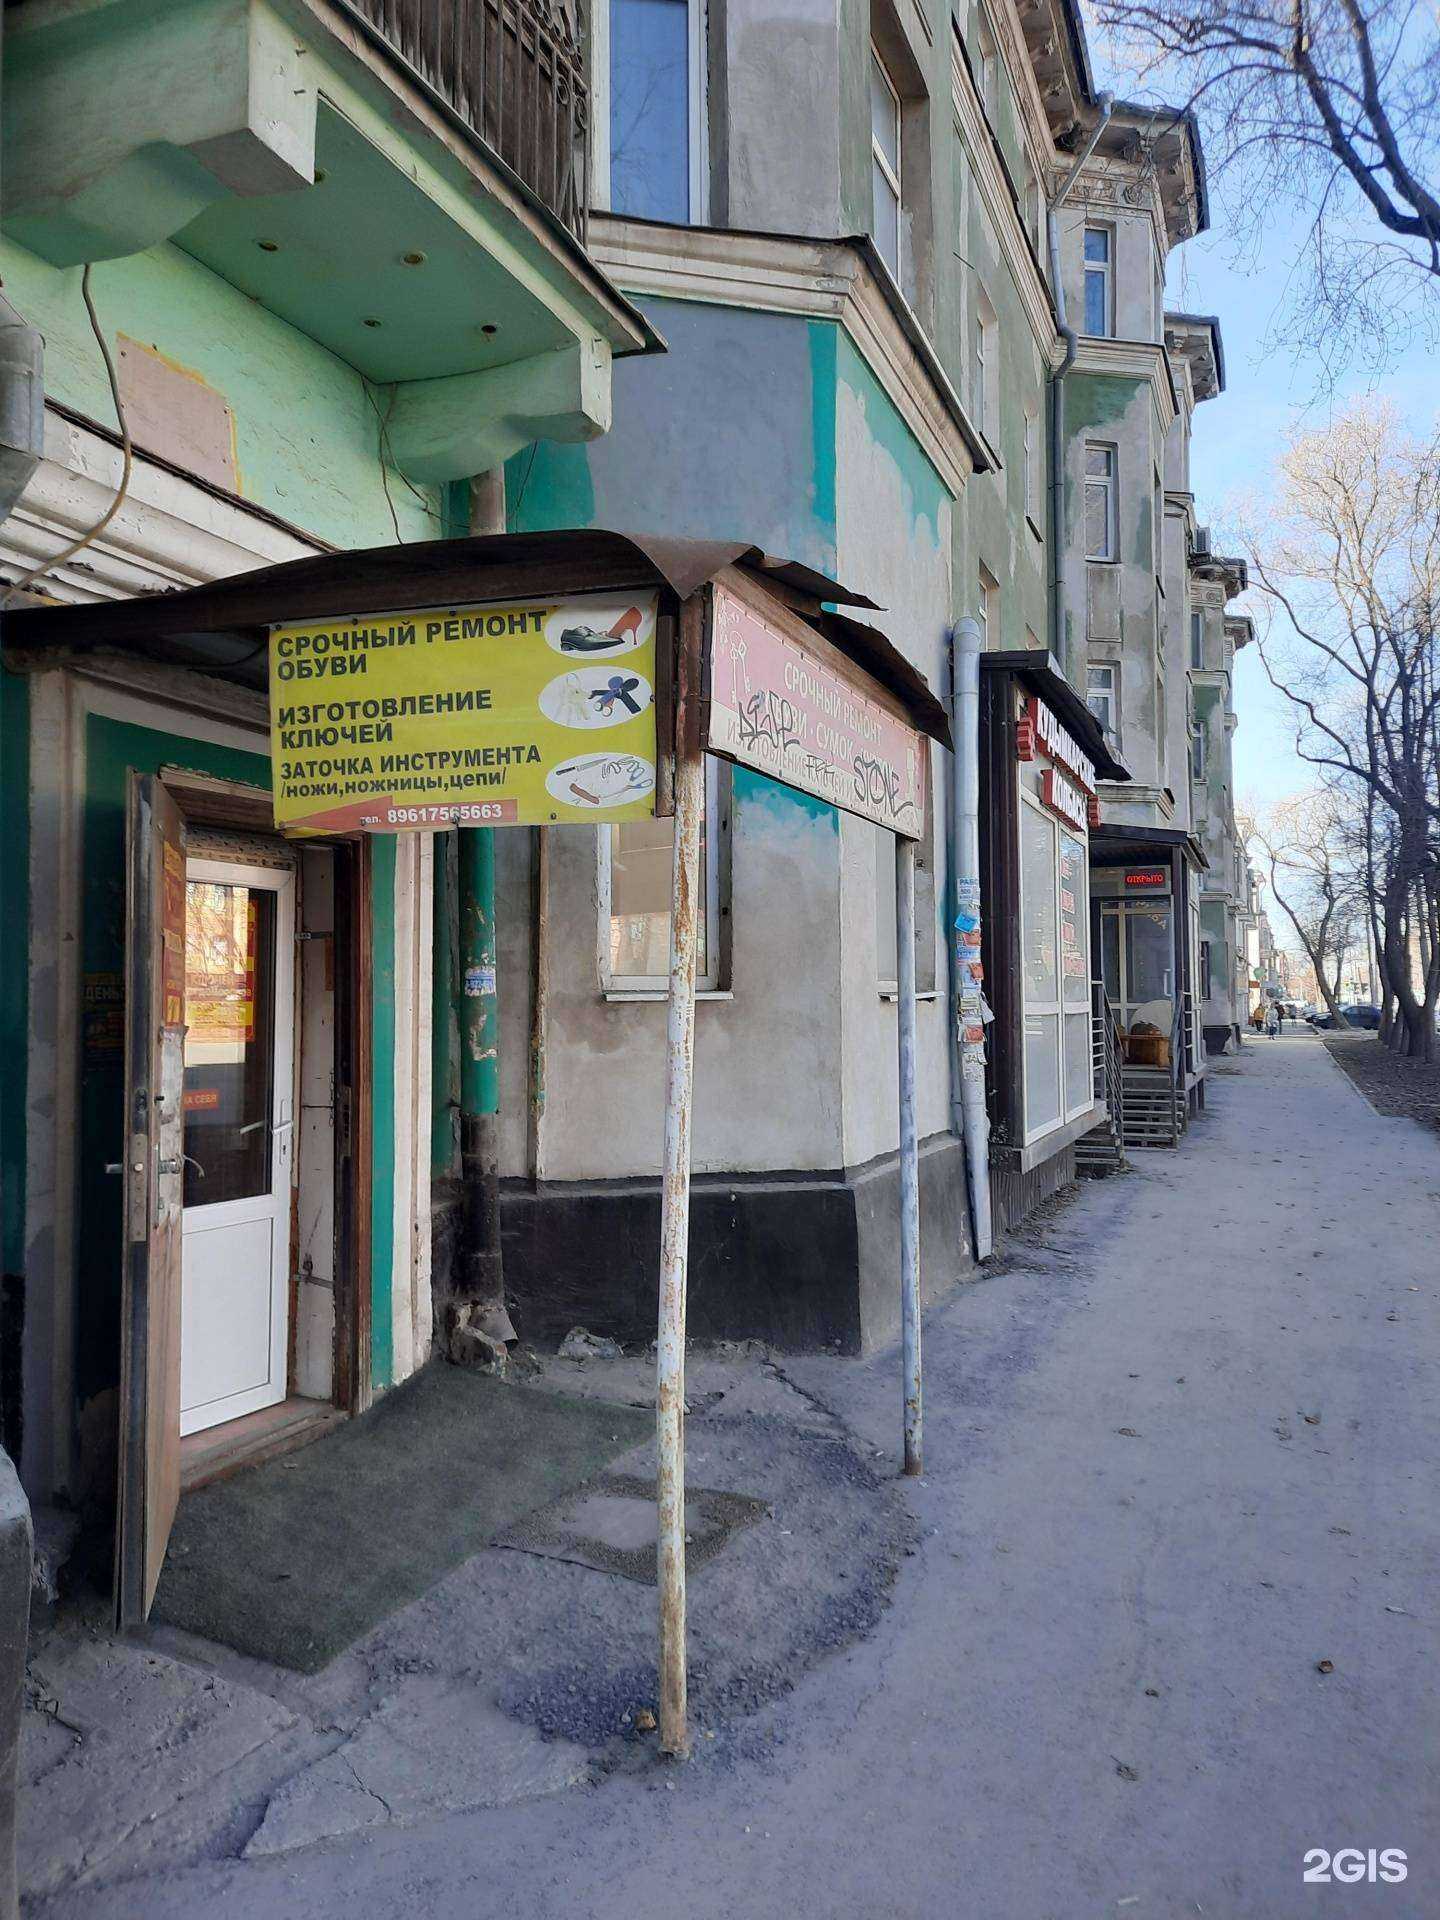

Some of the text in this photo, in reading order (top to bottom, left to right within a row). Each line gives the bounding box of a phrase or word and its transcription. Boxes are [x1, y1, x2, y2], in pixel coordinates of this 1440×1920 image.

[277, 610, 547, 658] СРОЧНЫЙ РЕМОНТ
[277, 653, 367, 681] ОБУВИ
[279, 689, 492, 726] ИЗГОТОВЛЕНИЕ
[784, 661, 841, 719] СРОЧНЫЙ
[843, 701, 882, 745] РЕМОНТ
[281, 718, 393, 750] КЛЮЧЕЙ
[816, 721, 854, 766] СУМОК
[280, 744, 542, 780] ЗАТОЧКА ИНСТРУМЕНТА
[387, 804, 502, 824] 89617565663
[1126, 874, 1164, 884] ОТКРЫТО
